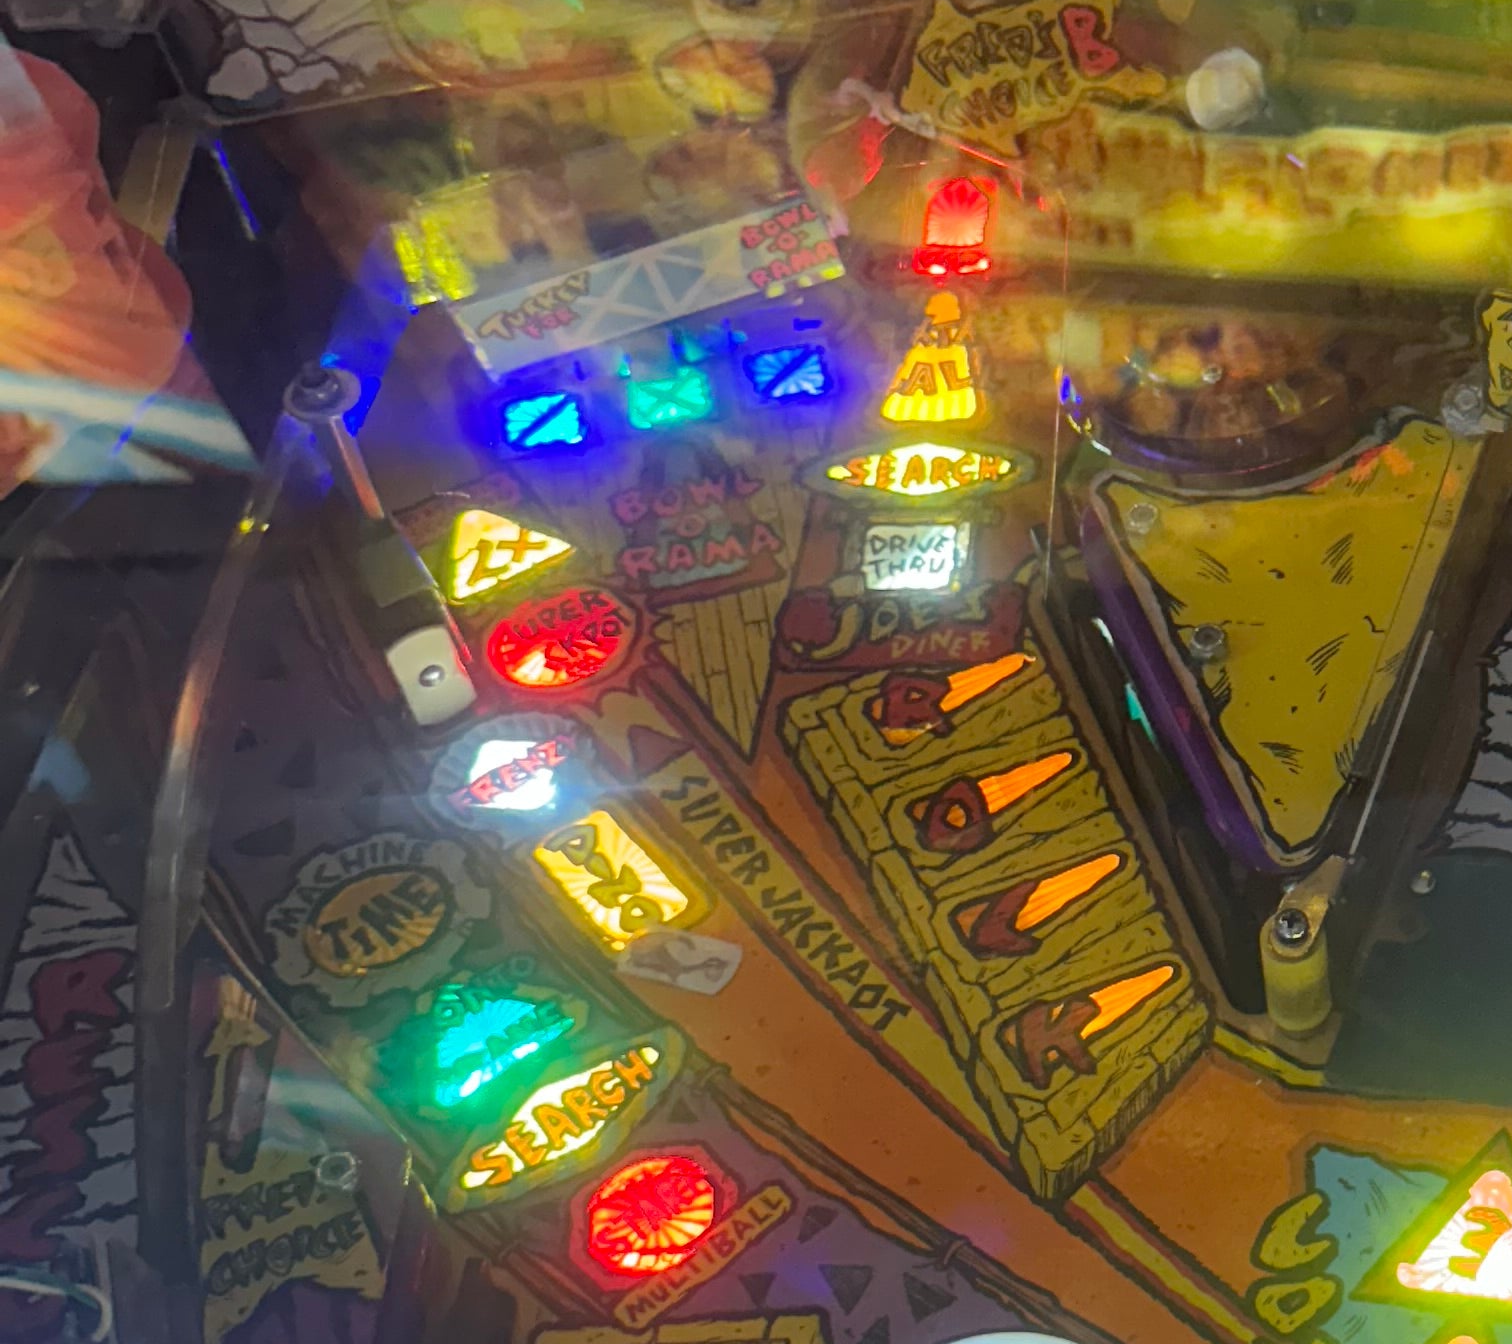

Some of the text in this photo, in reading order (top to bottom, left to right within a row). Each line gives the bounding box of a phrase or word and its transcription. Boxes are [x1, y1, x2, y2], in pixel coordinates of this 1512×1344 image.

[845, 452, 1003, 490] SEARCH
[868, 534, 951, 555] DRIVE
[868, 557, 948, 583] THRU
[508, 590, 612, 641] UPER
[542, 822, 665, 934] DINO
[660, 774, 910, 1030] SUPER JACKPOT
[470, 1049, 654, 1187] SEARCH
[624, 1193, 785, 1324] MULTIBALL
